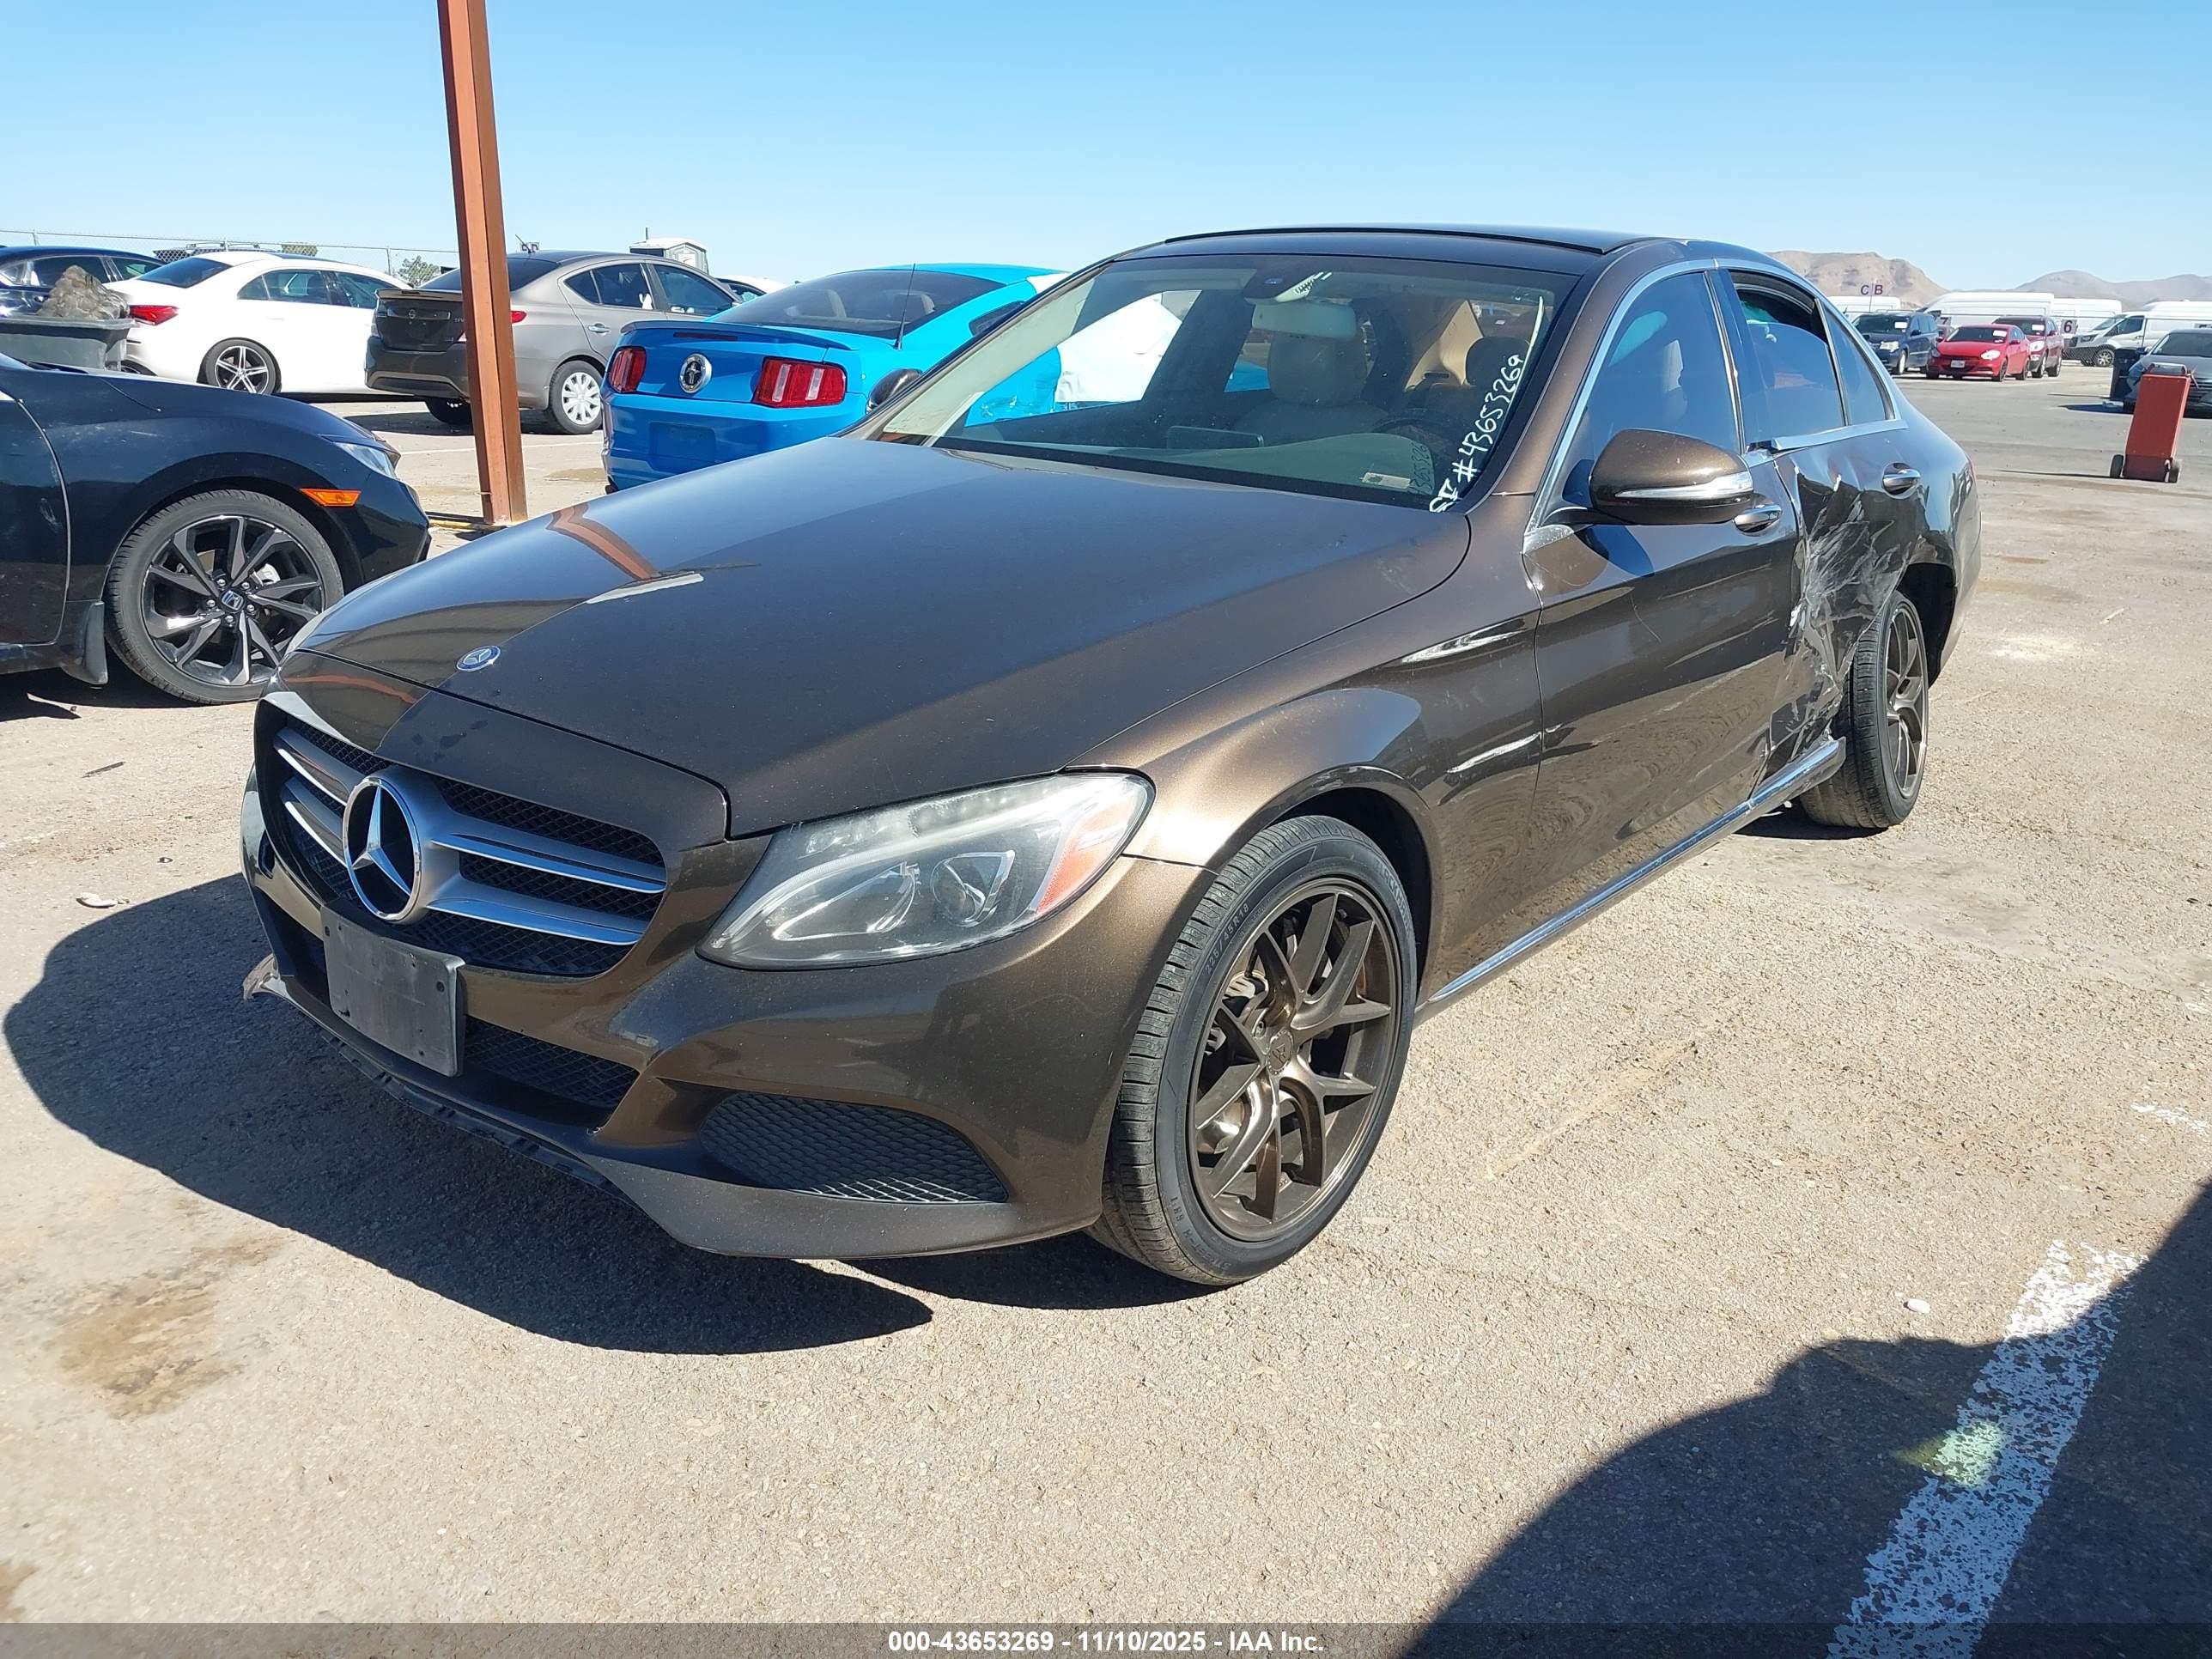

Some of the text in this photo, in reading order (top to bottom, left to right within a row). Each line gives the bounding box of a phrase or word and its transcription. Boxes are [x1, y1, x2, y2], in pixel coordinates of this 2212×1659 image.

[1860, 284, 1883, 295] C B
[2063, 319, 2072, 333] 6
[1204, 902, 1249, 975] 225/45R18
